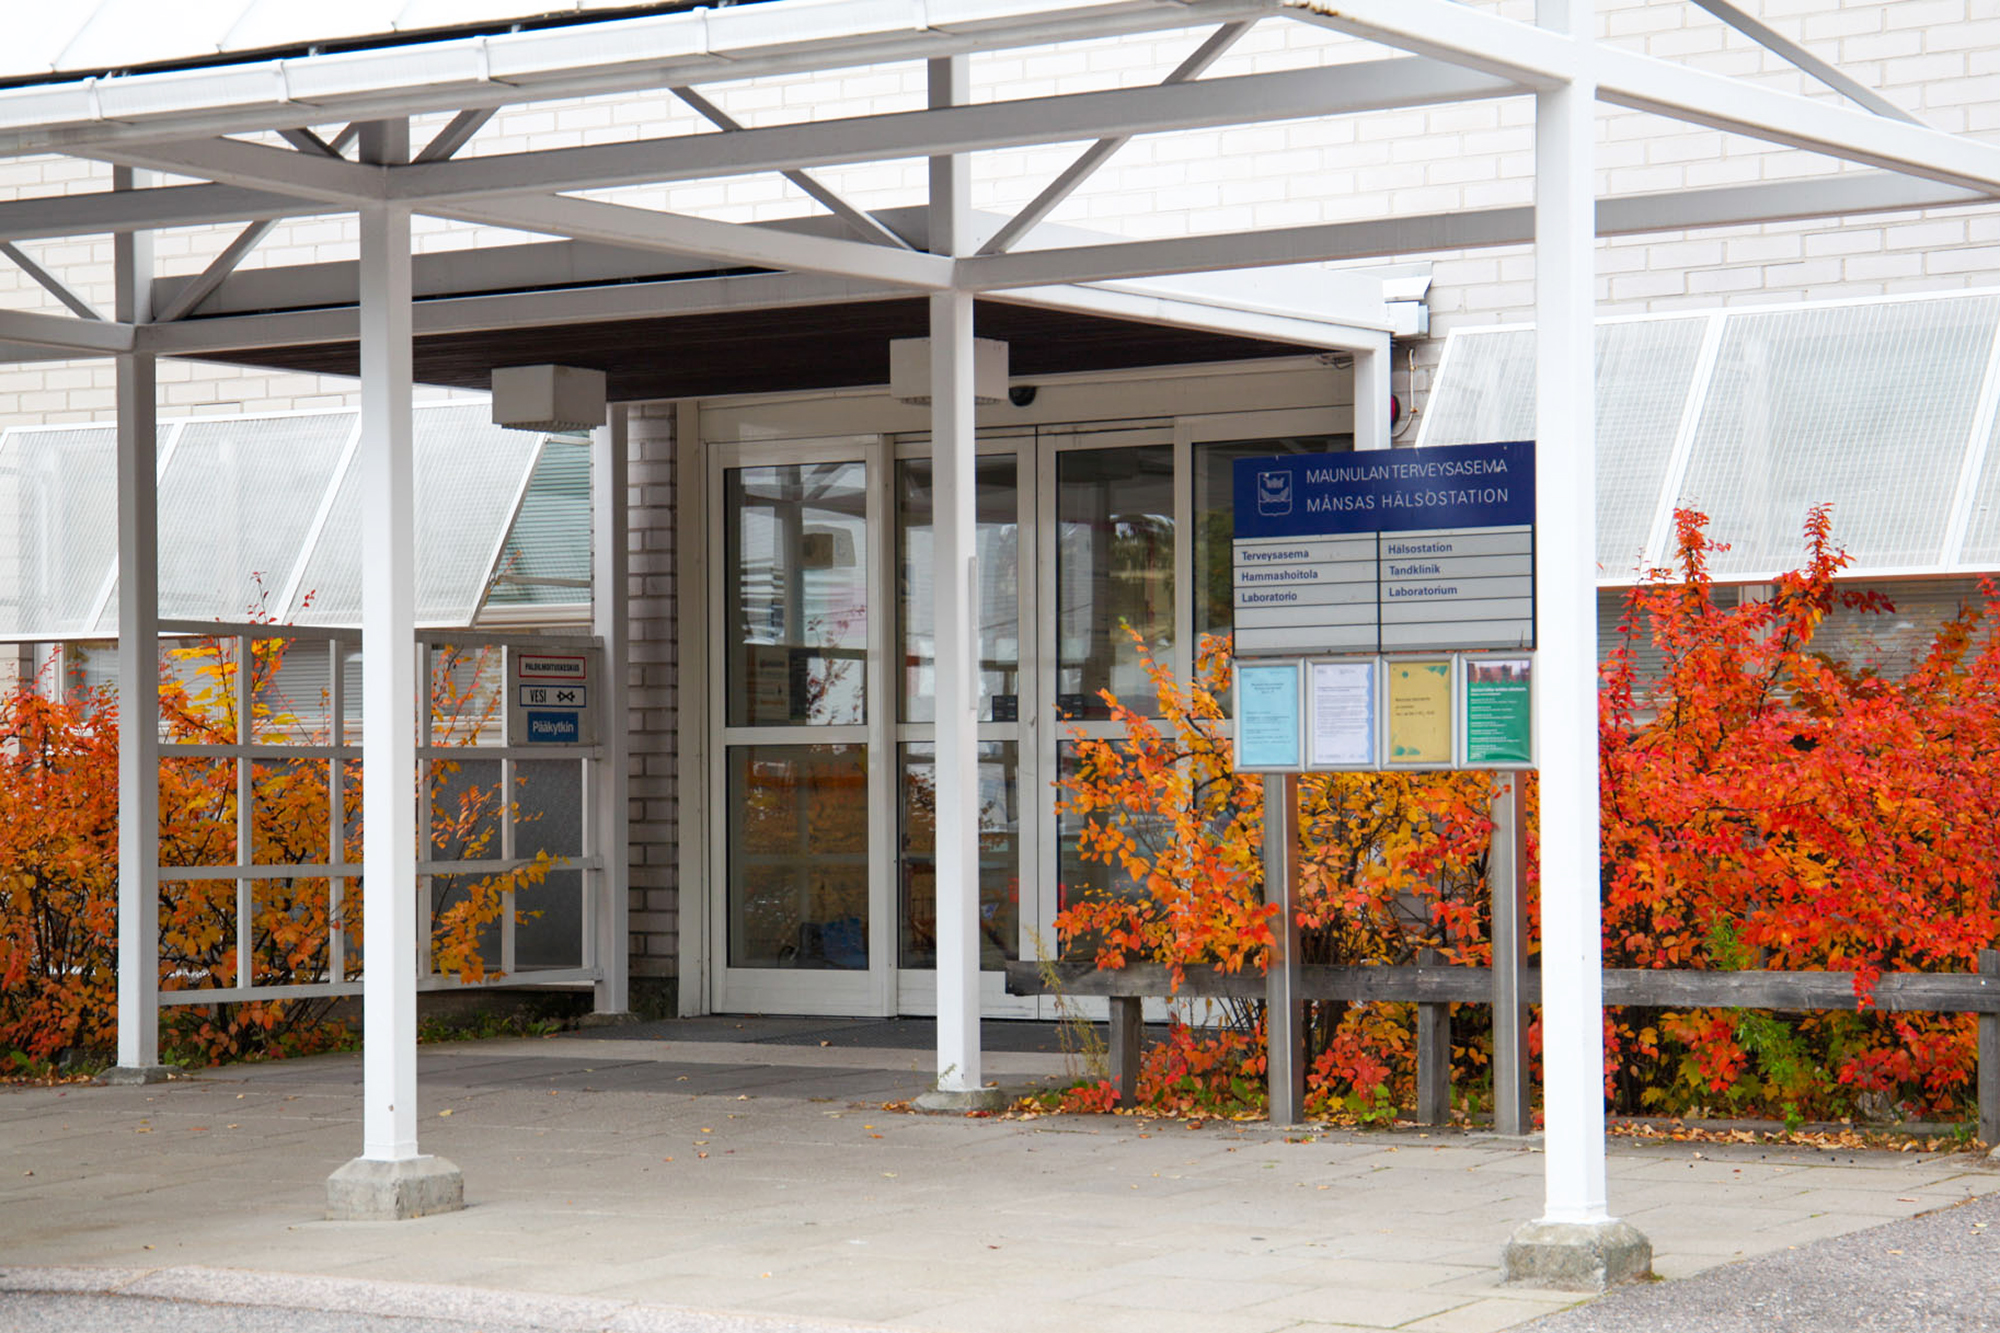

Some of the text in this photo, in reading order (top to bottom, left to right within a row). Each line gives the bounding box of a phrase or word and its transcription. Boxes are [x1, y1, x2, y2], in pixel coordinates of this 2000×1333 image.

[1306, 459, 1508, 484] MAUNULAN TERVEYSASEMA
[1306, 488, 1509, 512] MÅNSAS HÄLSOSTATION
[1388, 543, 1453, 555] Hälsostation
[1242, 550, 1309, 562] Terveysasema
[1241, 569, 1318, 582] Hammashoitola
[1389, 564, 1441, 576] Tandklinik
[1241, 591, 1298, 603] Laboratorio
[1388, 585, 1458, 597] Laboratorium
[530, 689, 547, 703] VESI
[532, 721, 574, 735] Pääkytkin
